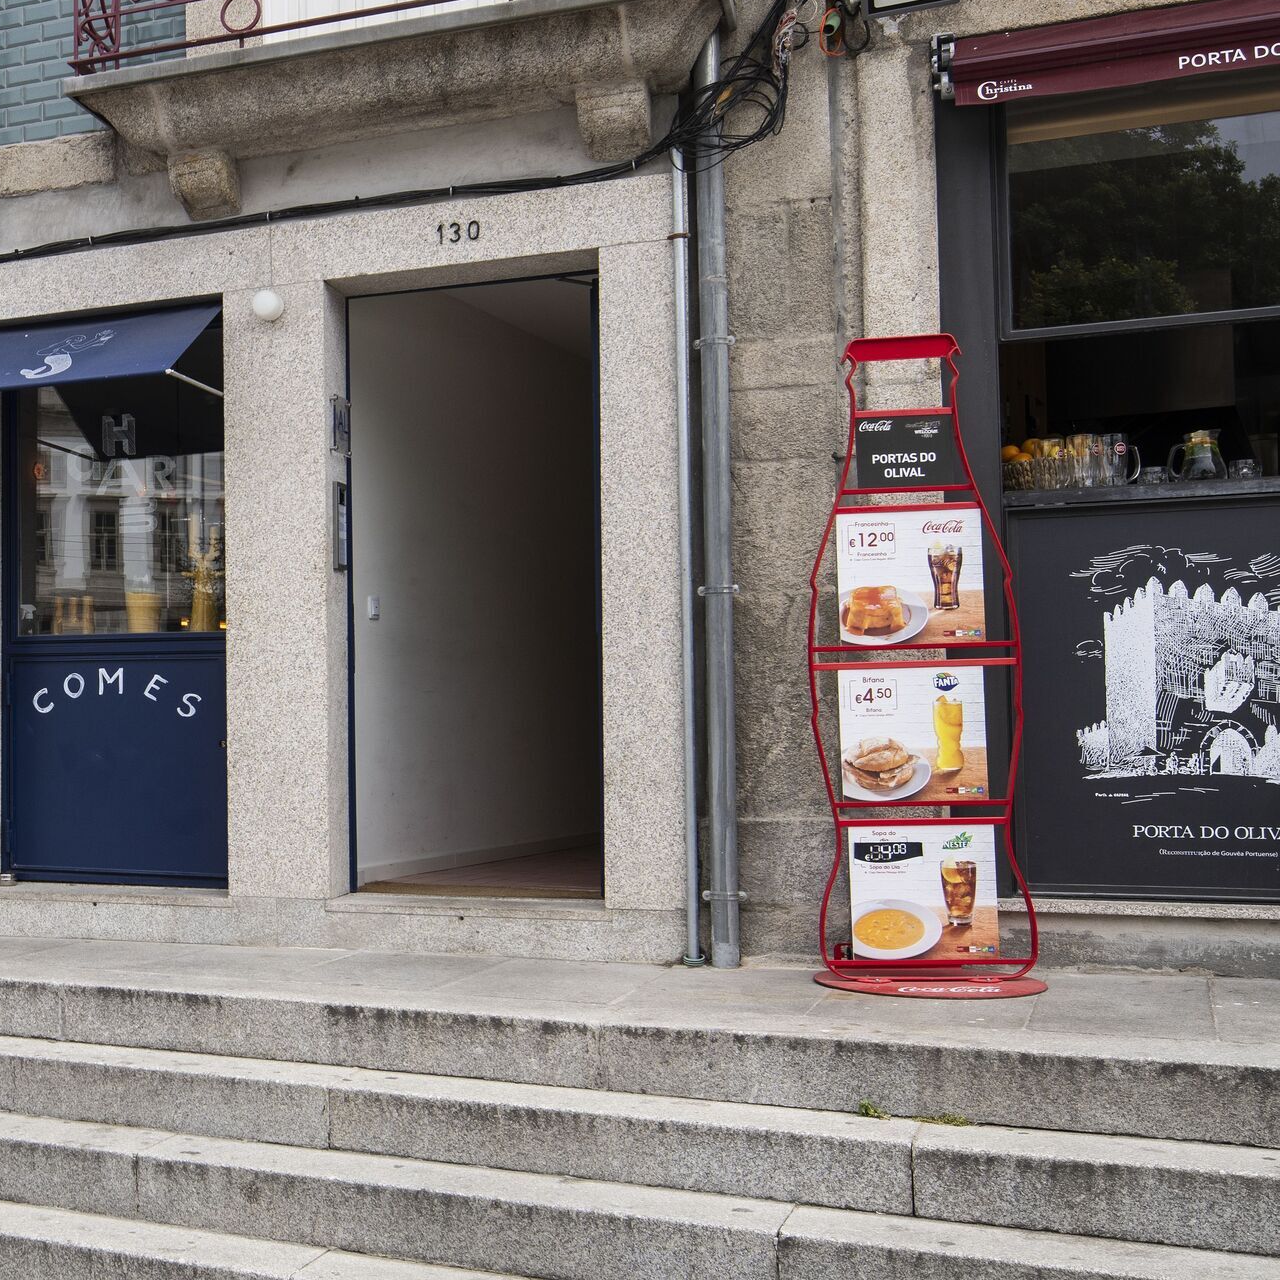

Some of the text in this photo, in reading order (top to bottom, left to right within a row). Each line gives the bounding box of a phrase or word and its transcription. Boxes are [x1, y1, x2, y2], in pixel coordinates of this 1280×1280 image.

[1178, 48, 1247, 70] PORTA
[977, 81, 1033, 100] Christina
[436, 220, 480, 245] 130
[872, 452, 936, 464] PORTAS DO
[884, 467, 925, 478] OLIVAL
[922, 520, 963, 534] Coca-Cola
[933, 676, 959, 687] FANTA
[32, 667, 202, 717] COMES
[1132, 825, 1195, 839] PORTA
[1200, 825, 1229, 839] DO
